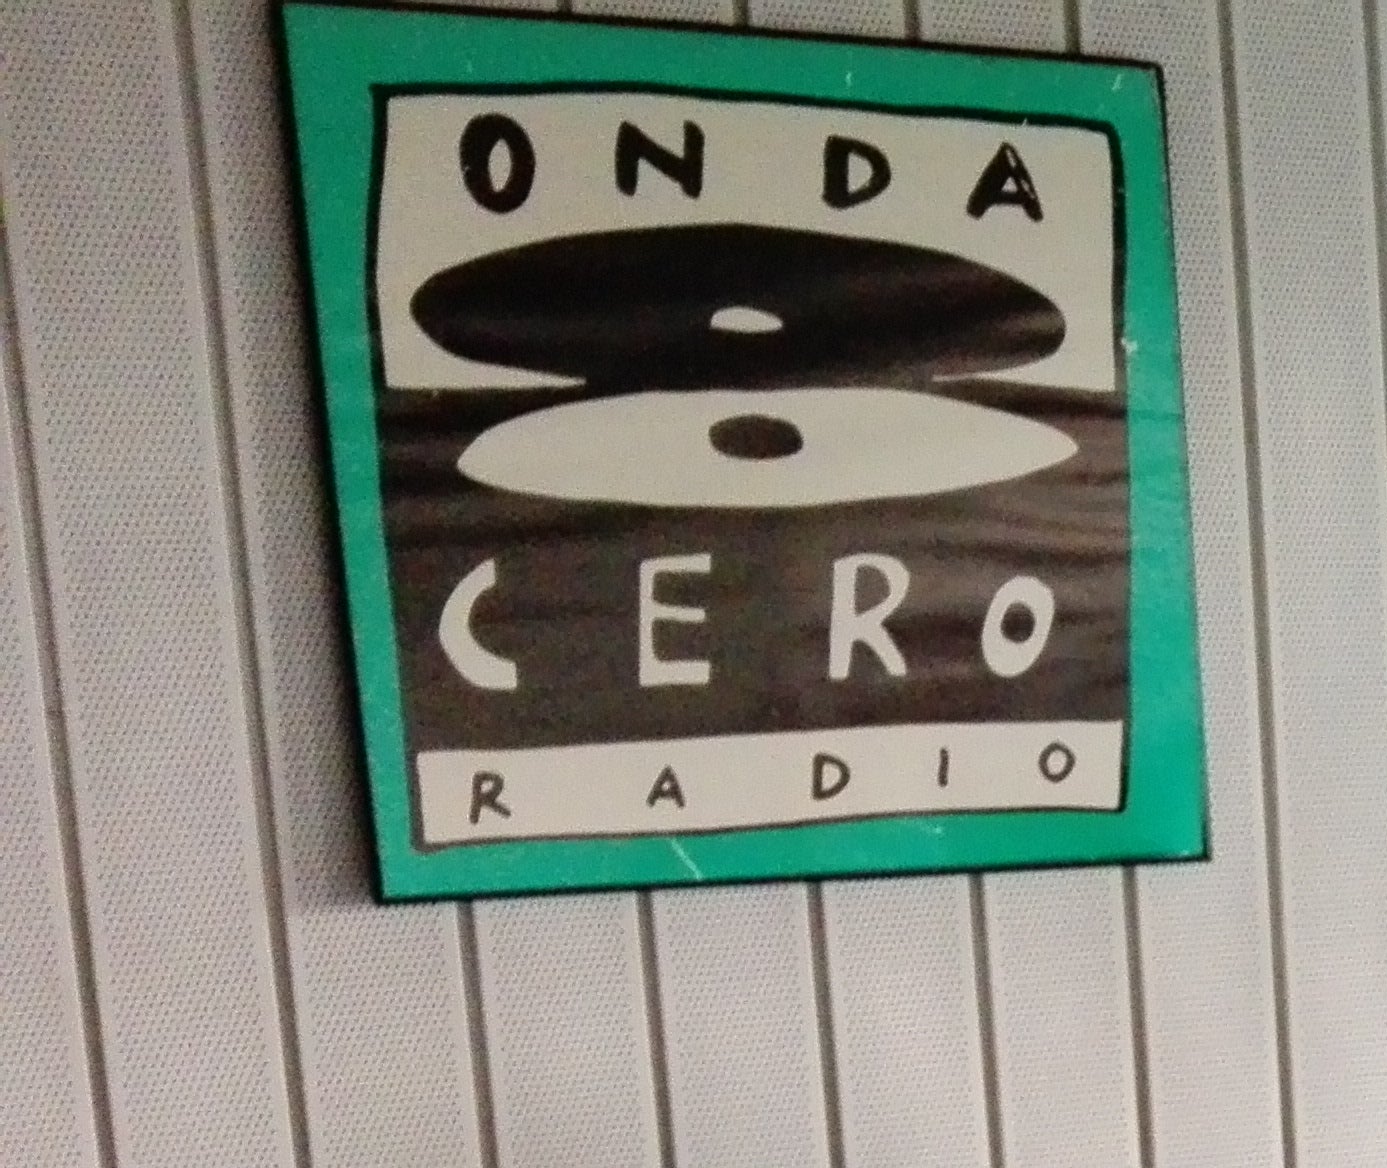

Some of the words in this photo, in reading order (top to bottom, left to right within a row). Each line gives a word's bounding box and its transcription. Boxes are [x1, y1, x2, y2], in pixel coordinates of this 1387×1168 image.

[458, 112, 1045, 222] ONDA
[438, 552, 1056, 692] CERO
[469, 742, 1076, 825] RADIO
